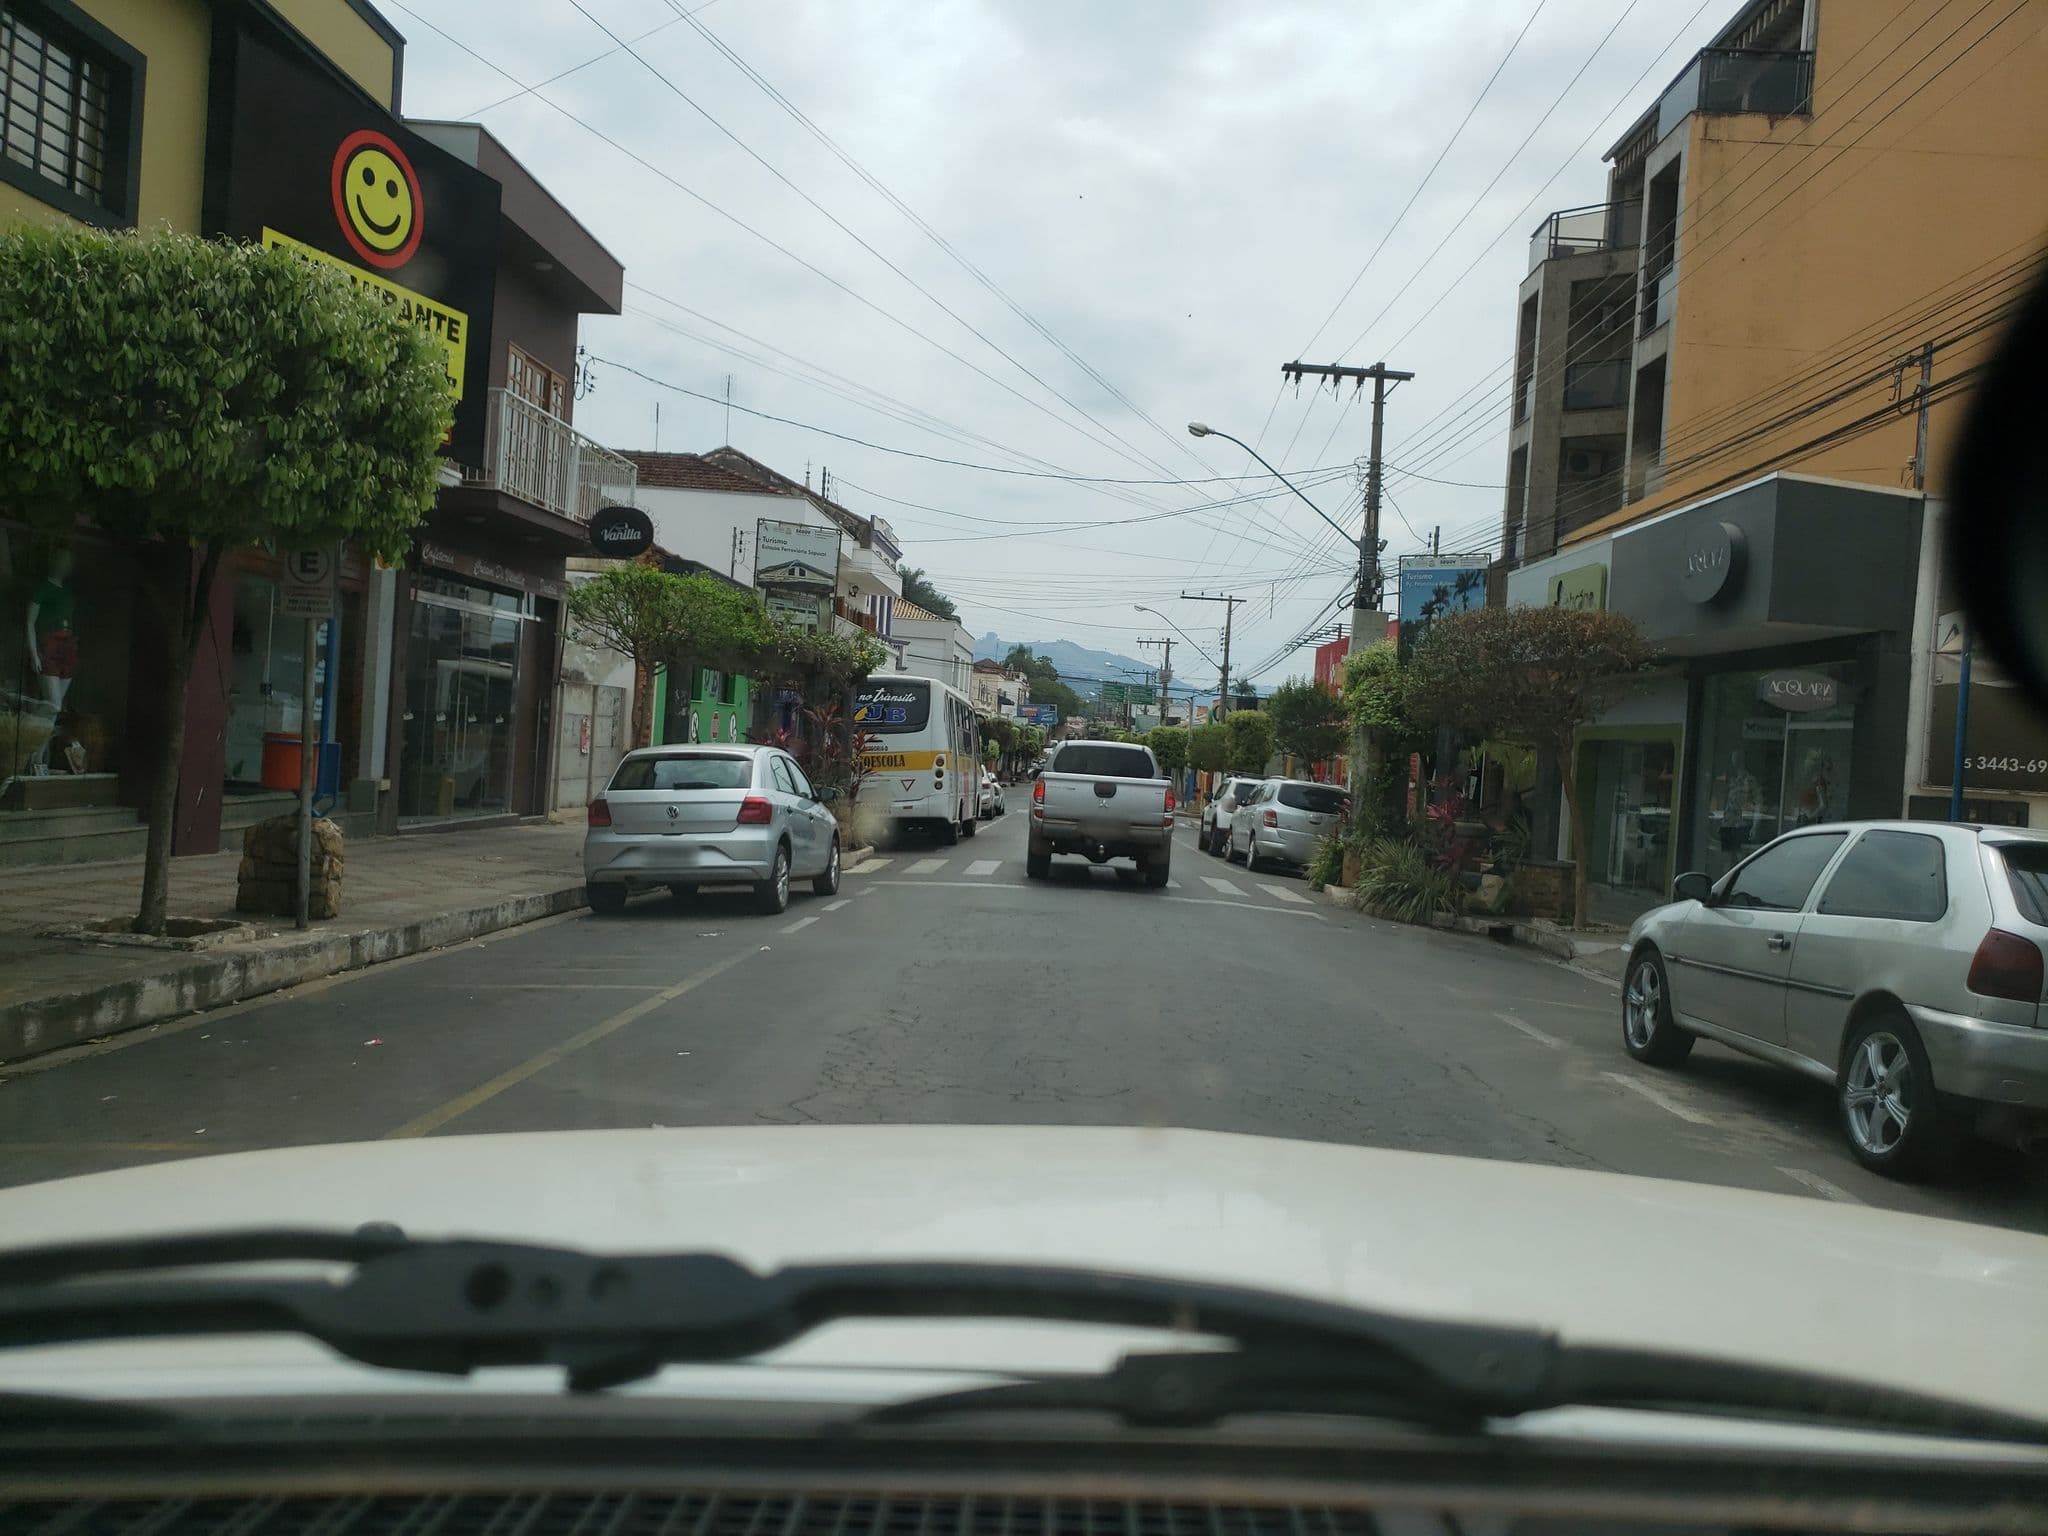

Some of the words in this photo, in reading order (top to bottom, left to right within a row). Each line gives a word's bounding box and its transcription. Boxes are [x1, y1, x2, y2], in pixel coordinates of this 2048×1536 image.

[600, 525, 641, 541] Vanilla
[762, 536, 788, 545] Turismo
[300, 551, 319, 574] E
[1407, 573, 1433, 581] Turismo
[859, 693, 873, 701] no
